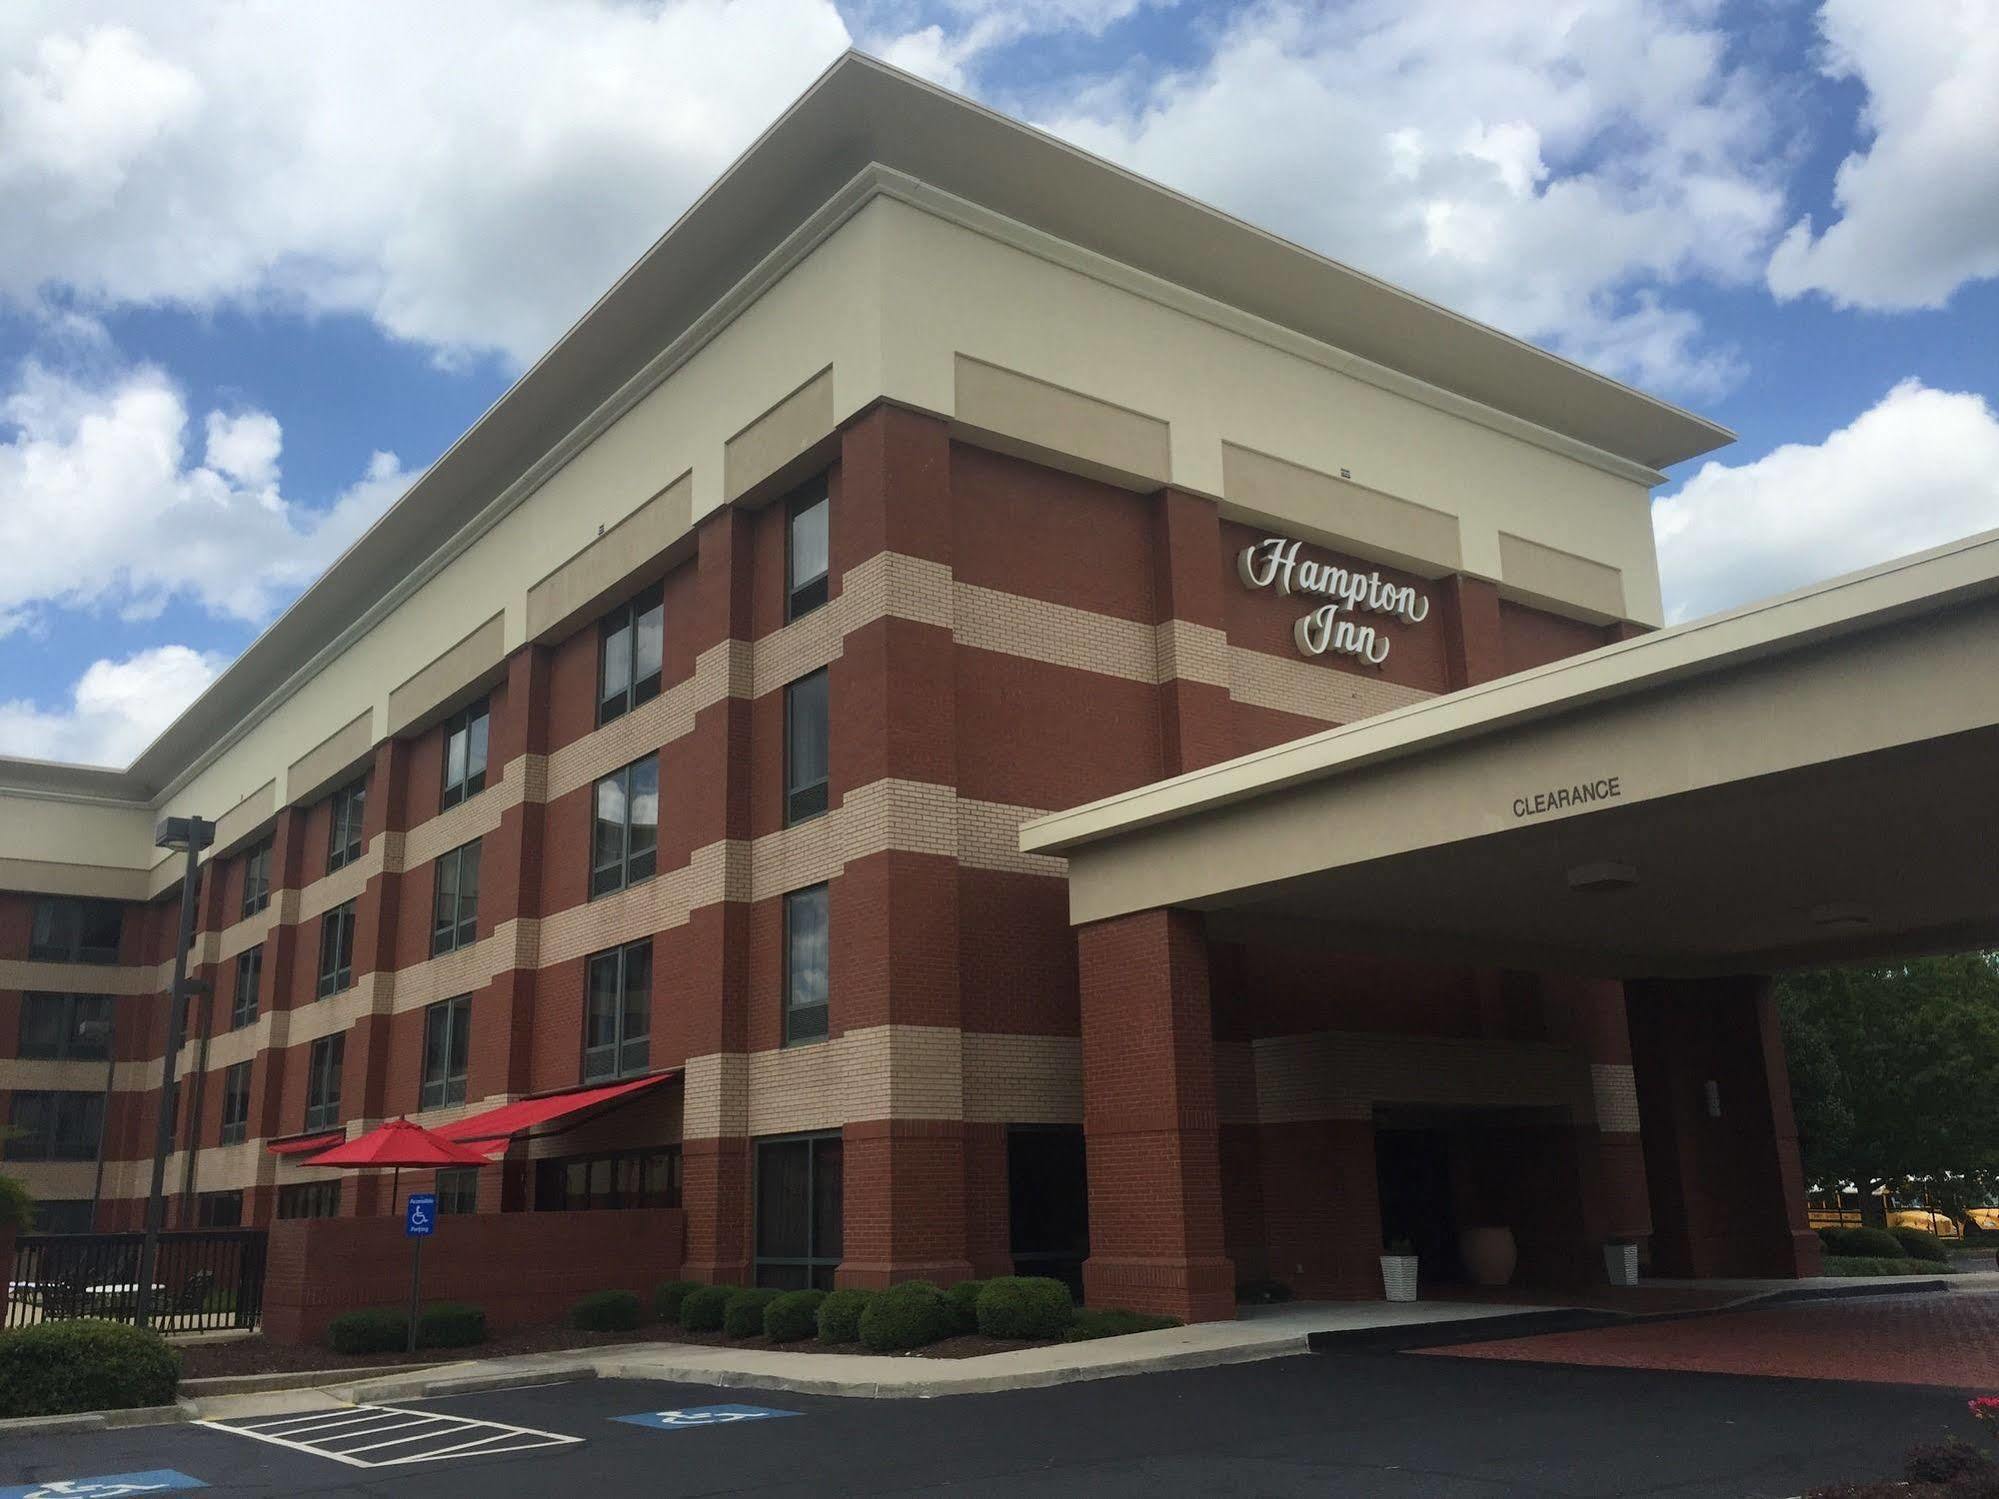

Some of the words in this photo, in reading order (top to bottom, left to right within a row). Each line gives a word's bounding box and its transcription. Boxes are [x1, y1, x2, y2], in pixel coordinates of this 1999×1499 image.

[1243, 538, 1429, 622] Hampton
[1301, 604, 1390, 664] Inn
[1513, 776, 1621, 817] CLEARANCE
